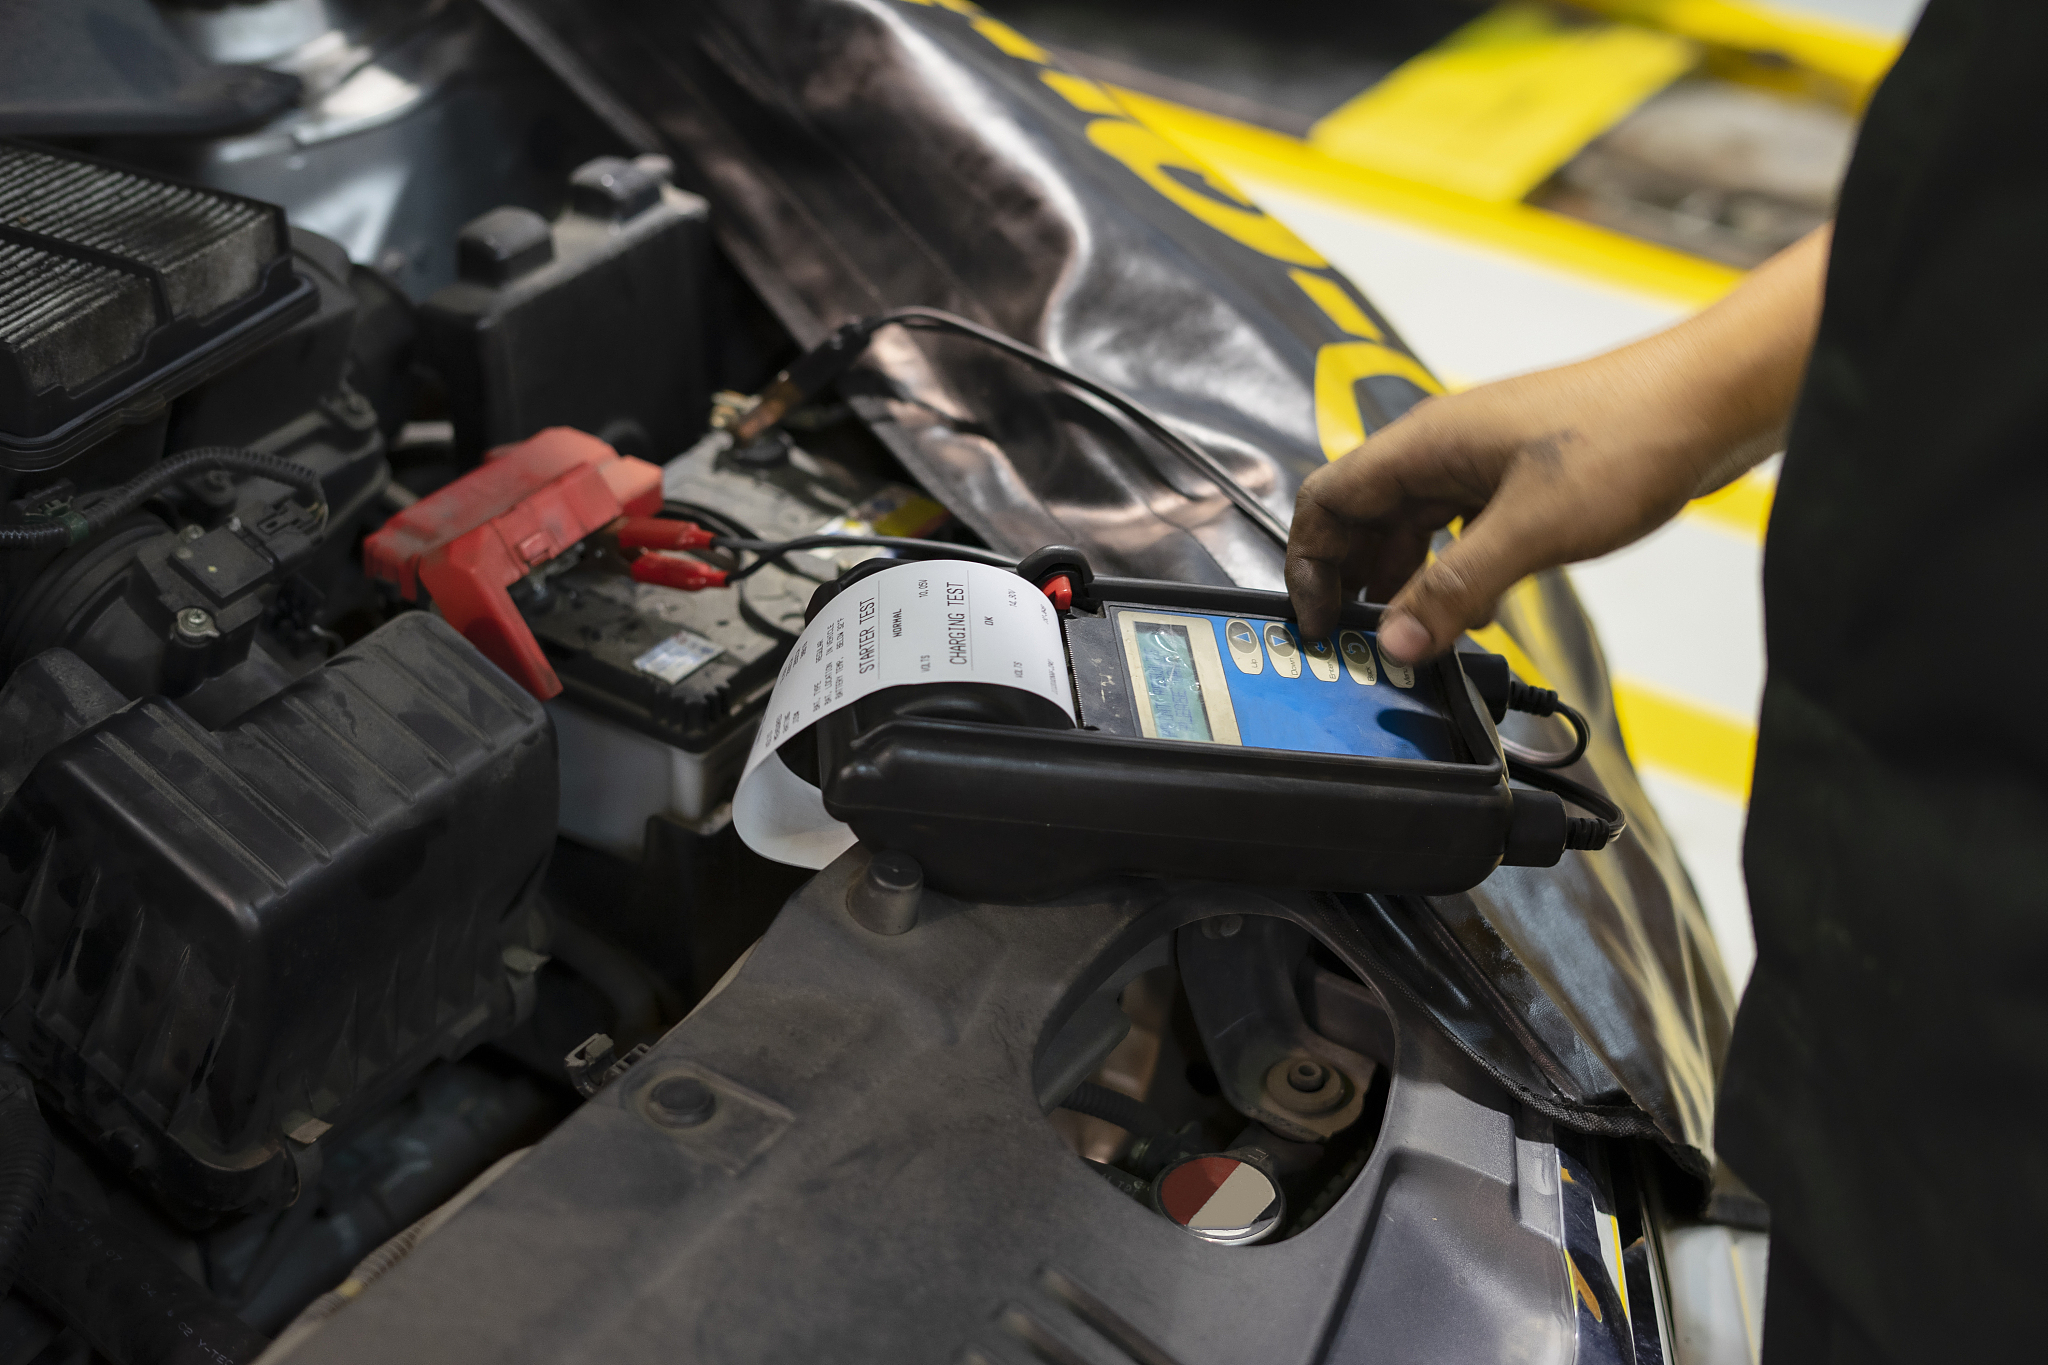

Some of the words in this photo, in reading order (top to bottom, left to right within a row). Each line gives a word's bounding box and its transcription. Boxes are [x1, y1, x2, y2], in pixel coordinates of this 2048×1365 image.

[946, 581, 965, 607] TEST
[859, 597, 875, 626] TEST
[984, 615, 994, 626] OK
[892, 608, 902, 638] NORMAL
[827, 622, 835, 645] VEHICLE
[836, 631, 845, 650] BELOW
[948, 612, 967, 666] CHARGING
[815, 638, 824, 663] REGULAR
[826, 646, 834, 656] IN
[859, 625, 875, 675] STARTER
[920, 654, 931, 674] VOLTS
[1013, 660, 1023, 679] VOLTS
[1250, 657, 1259, 670] Up
[1290, 657, 1299, 677] Down
[1329, 661, 1337, 680] Enter
[824, 661, 833, 690] LOCATION
[1366, 665, 1375, 683] Back
[813, 680, 822, 697] TYPE
[835, 675, 844, 700] BATTERY
